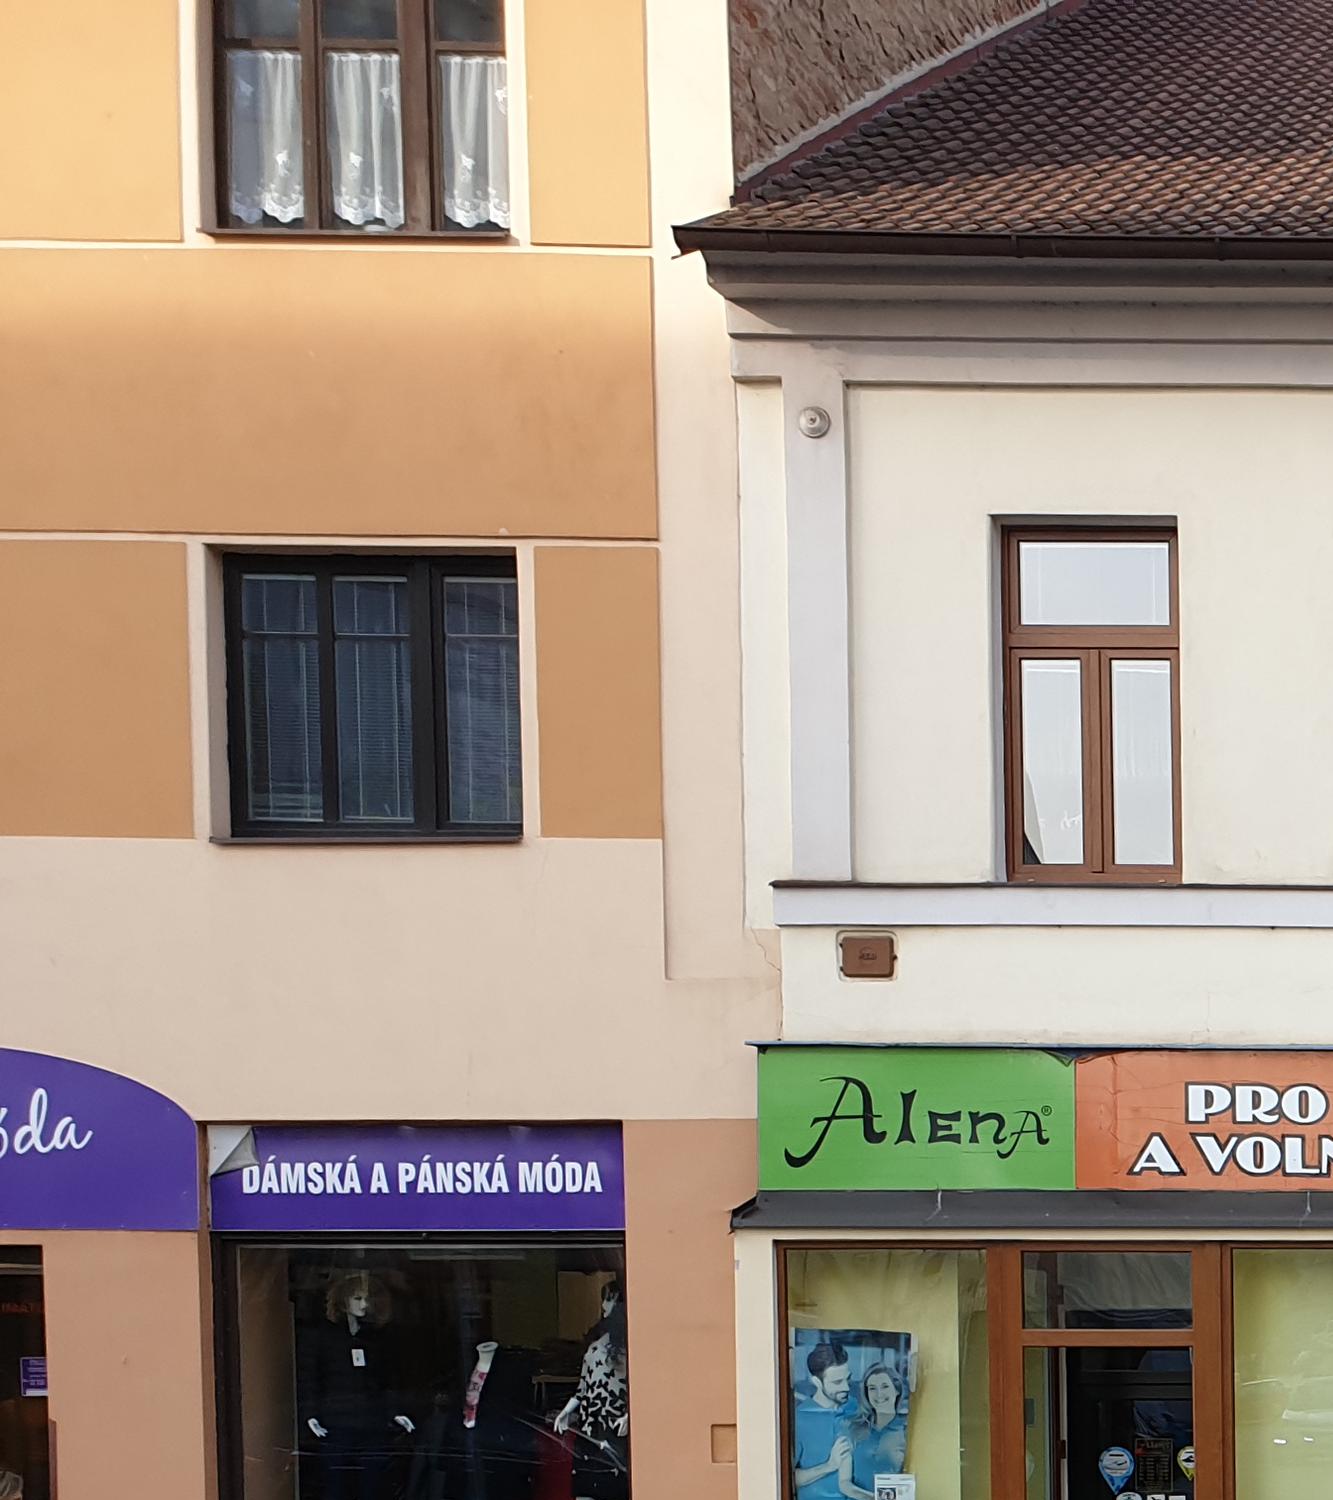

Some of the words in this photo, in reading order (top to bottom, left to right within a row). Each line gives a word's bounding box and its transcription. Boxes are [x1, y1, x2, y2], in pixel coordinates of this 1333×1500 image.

[1184, 1081, 1329, 1126] PRO
[242, 1154, 362, 1194] DÁMSKÁ
[370, 1162, 390, 1194] A
[398, 1154, 510, 1194] PÁNSKÁ
[519, 1154, 603, 1193] MÓDA
[1128, 1131, 1187, 1177] A
